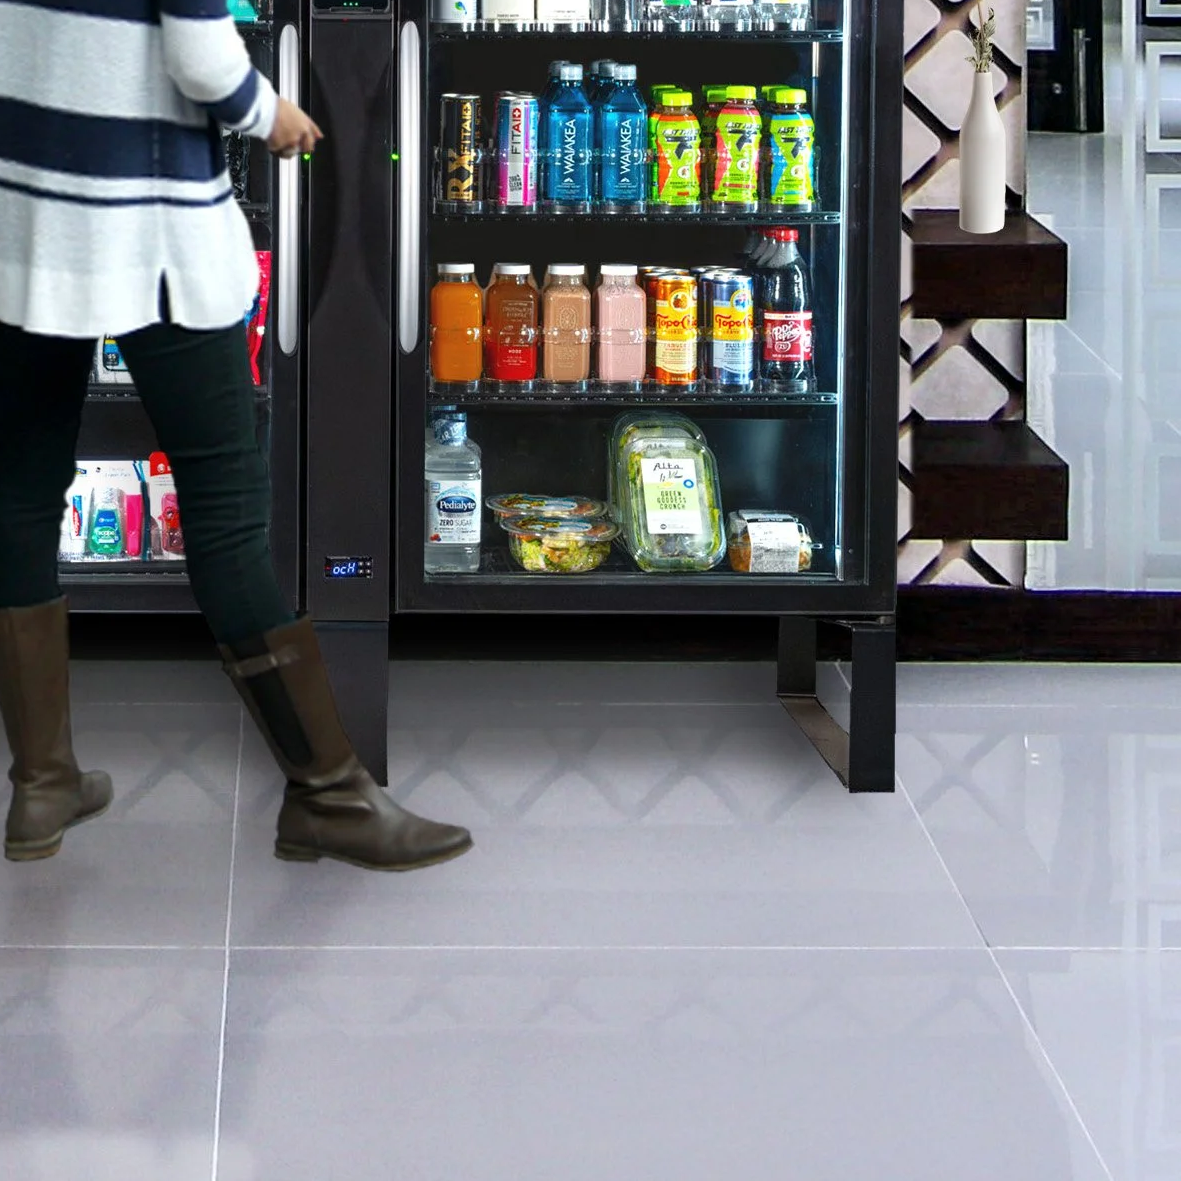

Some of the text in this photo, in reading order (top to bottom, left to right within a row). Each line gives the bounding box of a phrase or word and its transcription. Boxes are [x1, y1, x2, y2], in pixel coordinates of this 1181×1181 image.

[510, 107, 522, 155] FITAID
[563, 118, 576, 175] WAIAKEA
[619, 118, 632, 175] WAIAKEA
[656, 313, 680, 329] Topo
[714, 313, 742, 329] Topo
[439, 500, 476, 511] Pedialyte
[439, 519, 454, 527] ZERO
